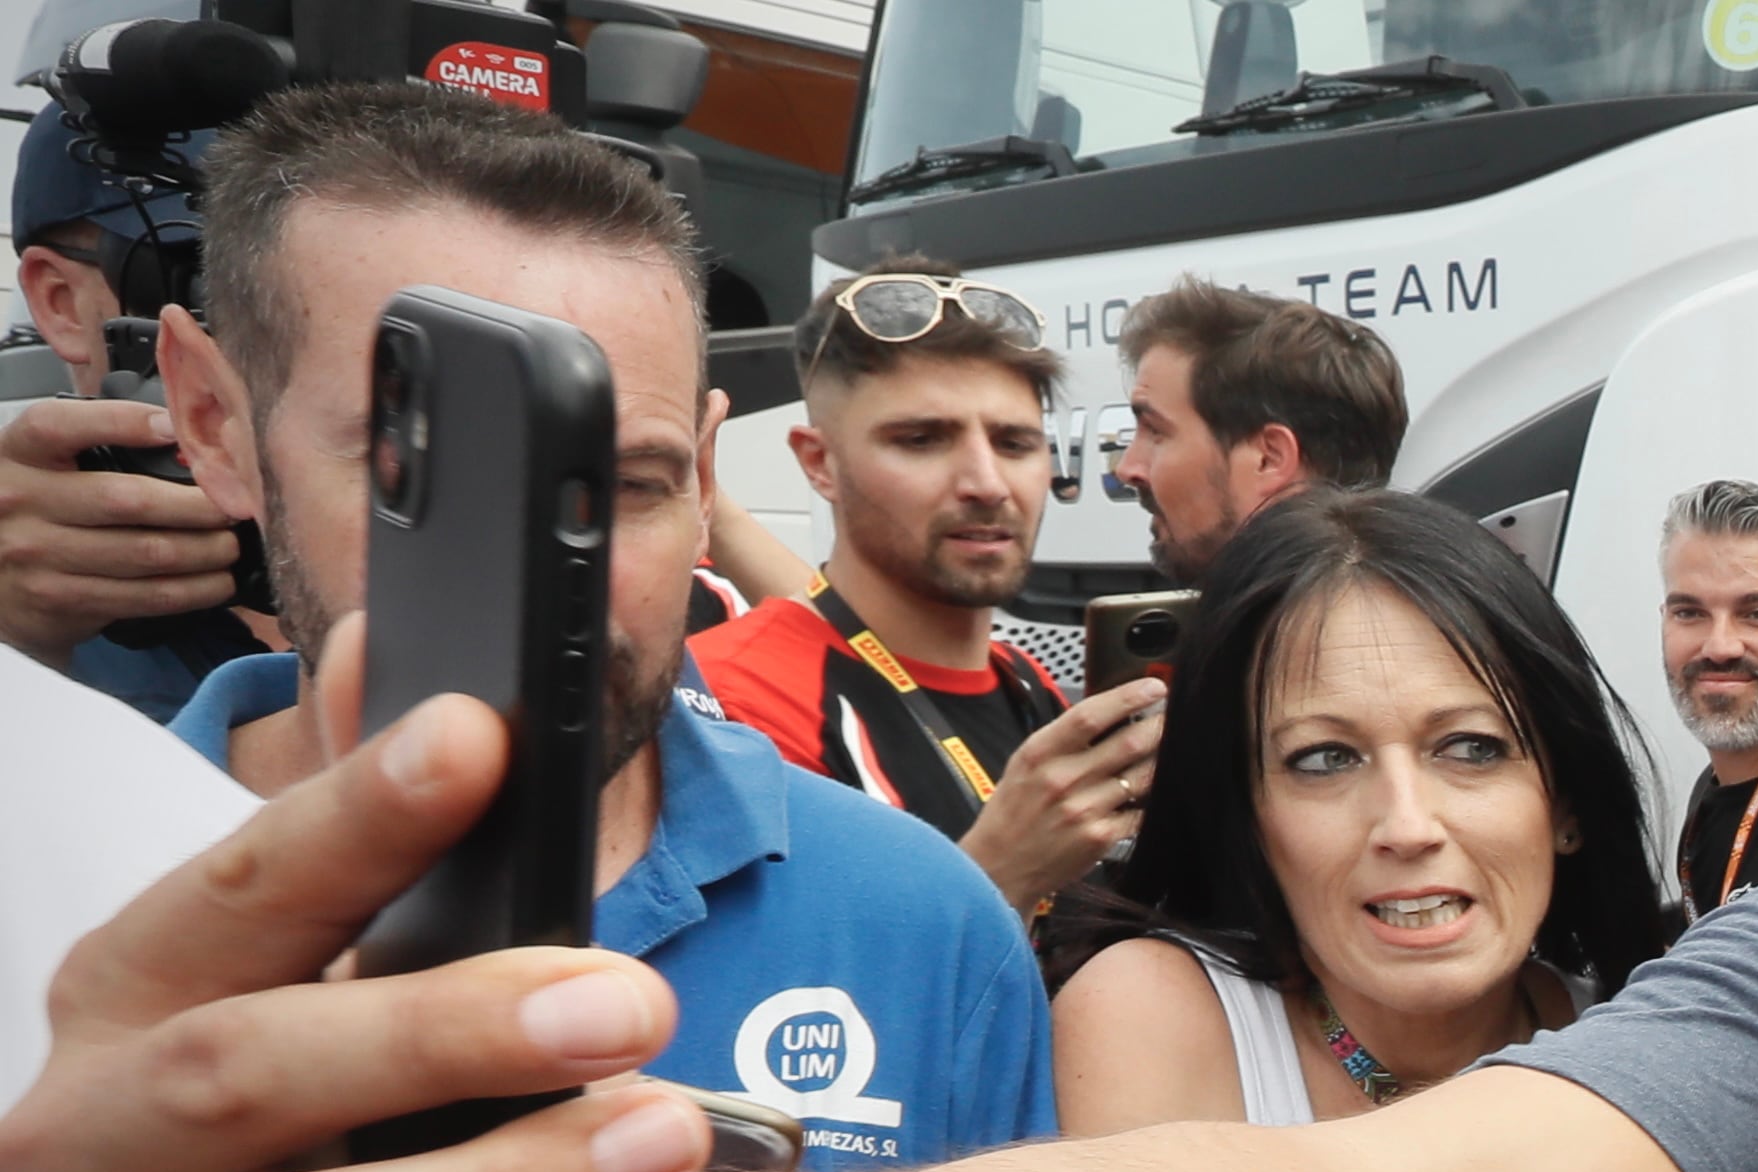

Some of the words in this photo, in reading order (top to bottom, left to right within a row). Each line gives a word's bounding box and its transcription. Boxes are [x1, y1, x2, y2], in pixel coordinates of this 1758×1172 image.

[439, 61, 540, 97] CAMERA
[1298, 258, 1499, 318] TEAM
[783, 1023, 840, 1050] UNI
[780, 1053, 836, 1080] LIM
